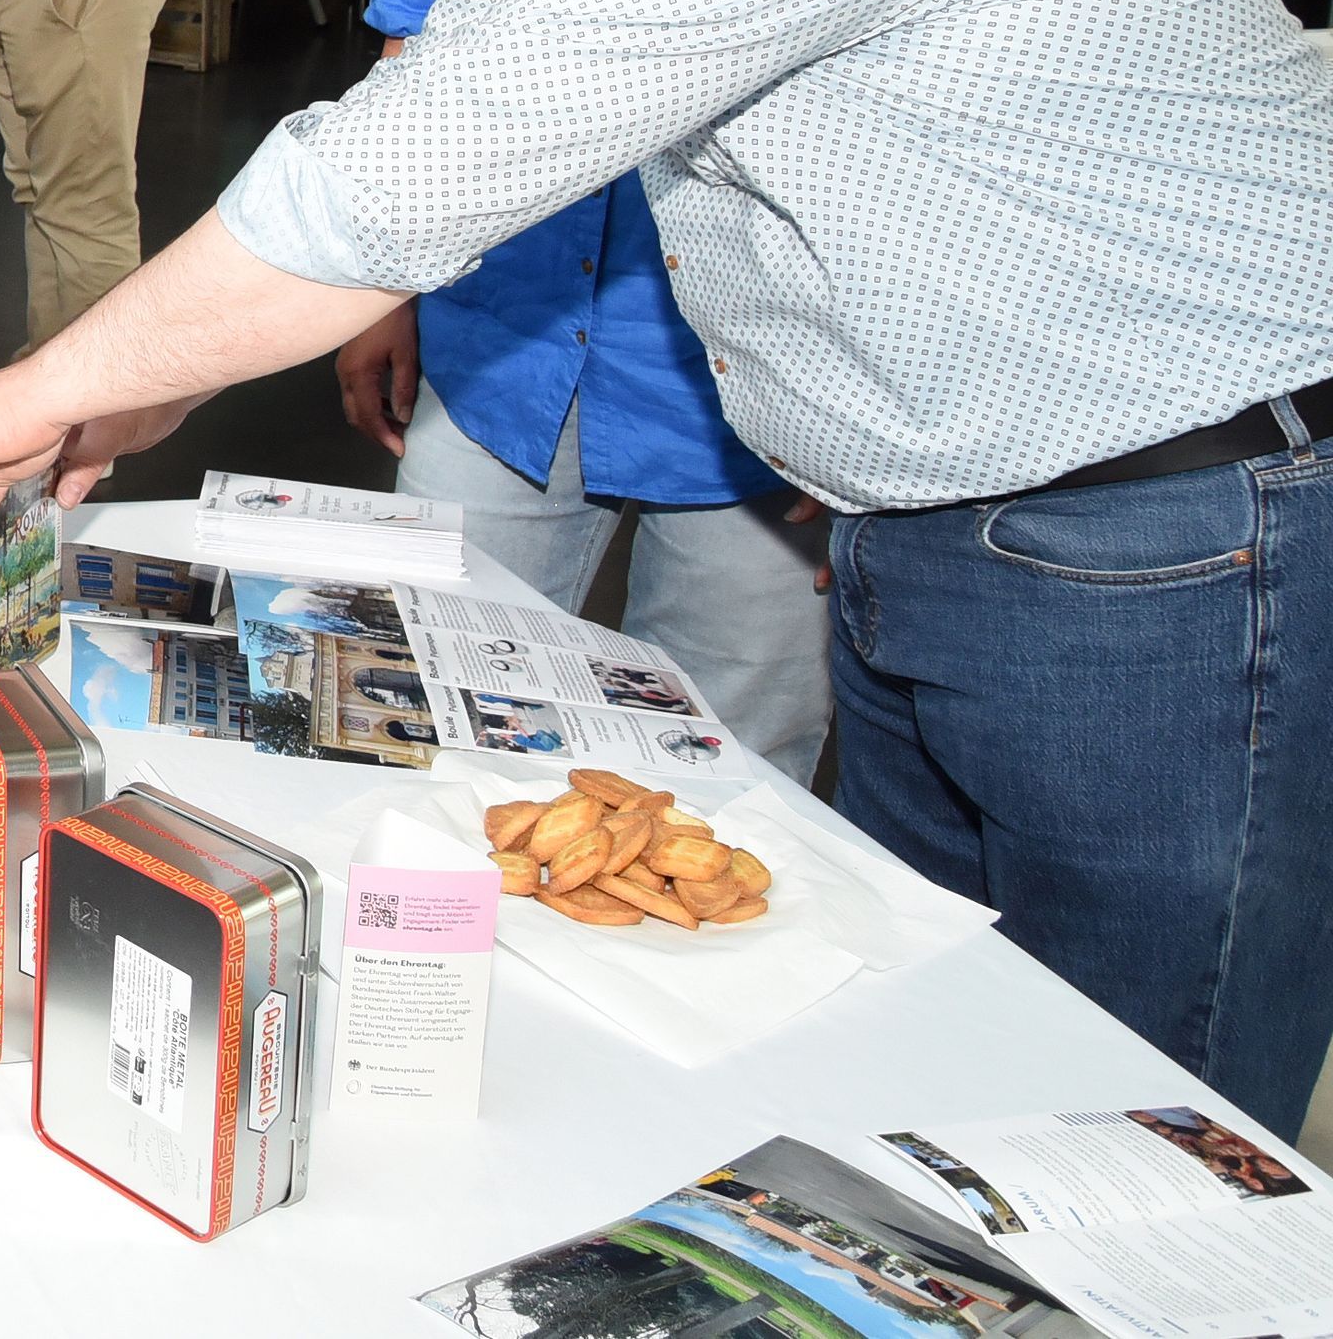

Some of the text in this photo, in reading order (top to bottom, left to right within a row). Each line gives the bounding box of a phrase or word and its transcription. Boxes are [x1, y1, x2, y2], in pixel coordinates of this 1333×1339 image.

[14, 499, 49, 543] ROYAN
[426, 659, 440, 679] Boule
[443, 715, 458, 739] Boule
[353, 966, 367, 974] Der
[369, 967, 401, 979] Ehrentag
[402, 971, 418, 979] wird
[355, 953, 446, 969] Über den Ehrentag:
[364, 1021, 396, 1032] Ehrentag
[175, 1013, 188, 1090] BOITE METAL
[258, 1006, 281, 1115] AUGEREAU
[273, 1023, 282, 1090] BISCUITERIE
